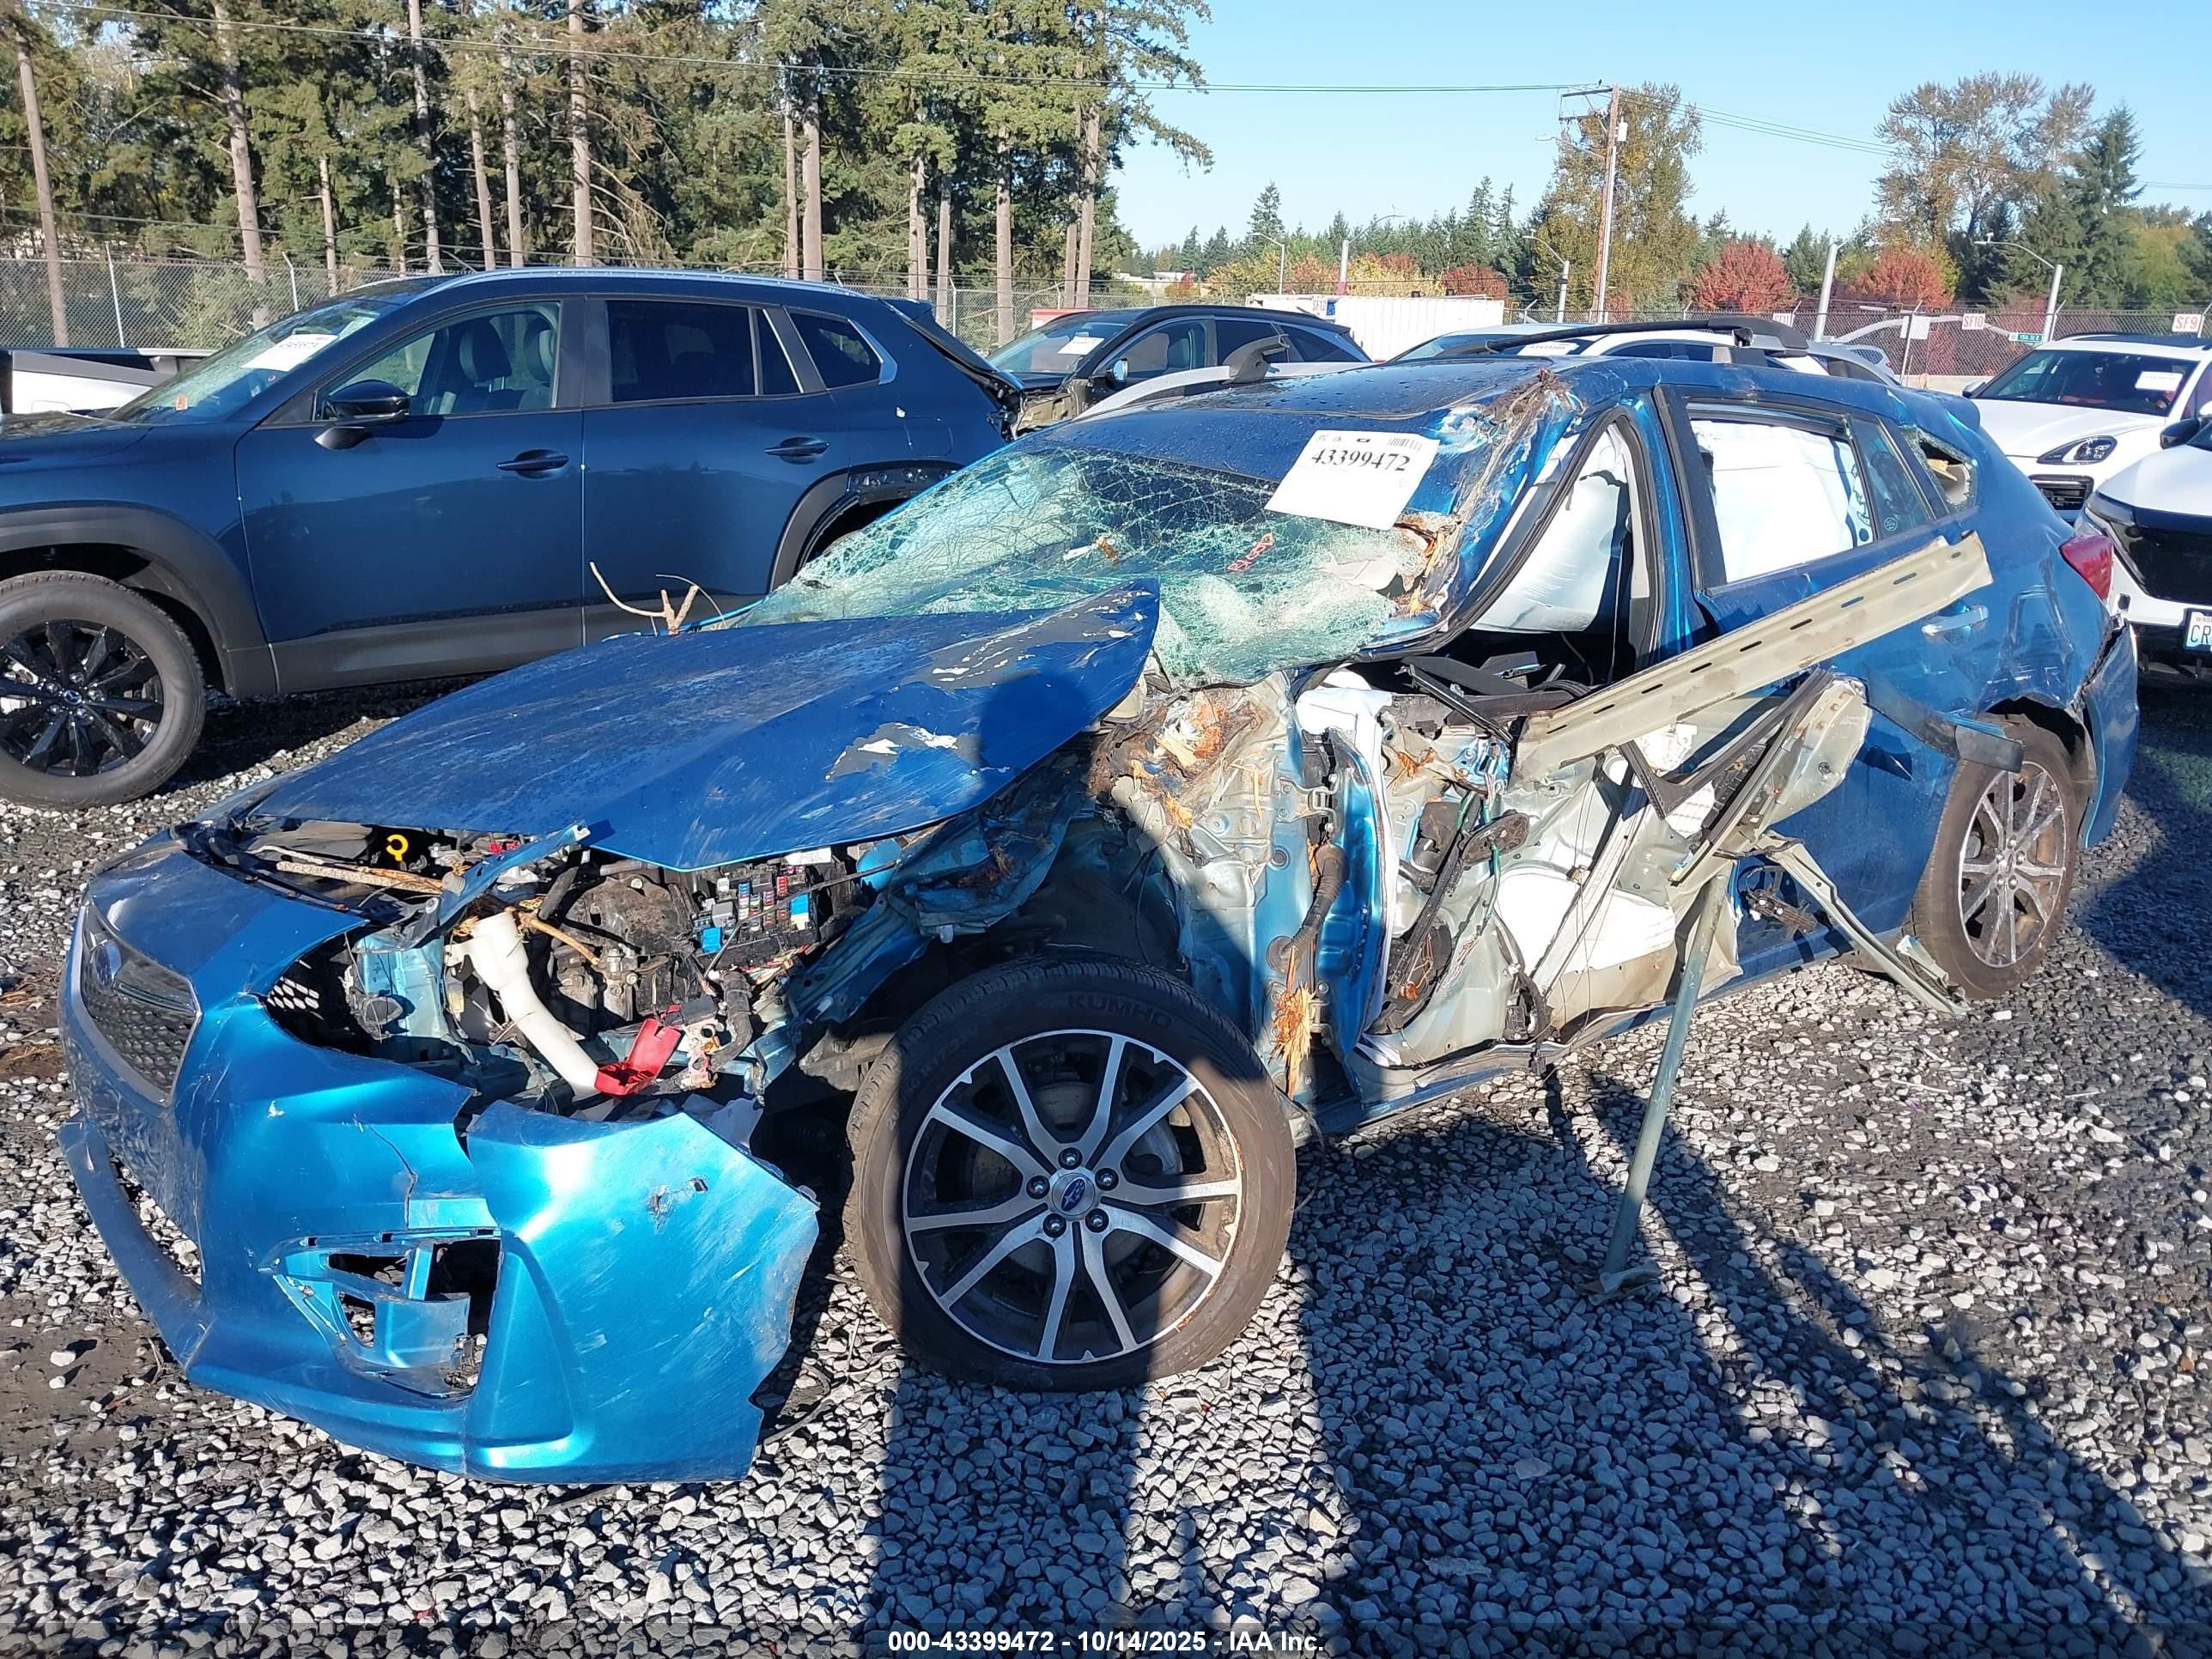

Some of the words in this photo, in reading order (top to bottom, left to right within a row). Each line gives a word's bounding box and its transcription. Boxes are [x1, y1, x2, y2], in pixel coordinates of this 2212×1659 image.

[1963, 315, 1984, 327] SF10
[2175, 316, 2198, 329] SF9
[1311, 447, 1411, 471] 43399472
[1067, 994, 1174, 1030] KUMHO
